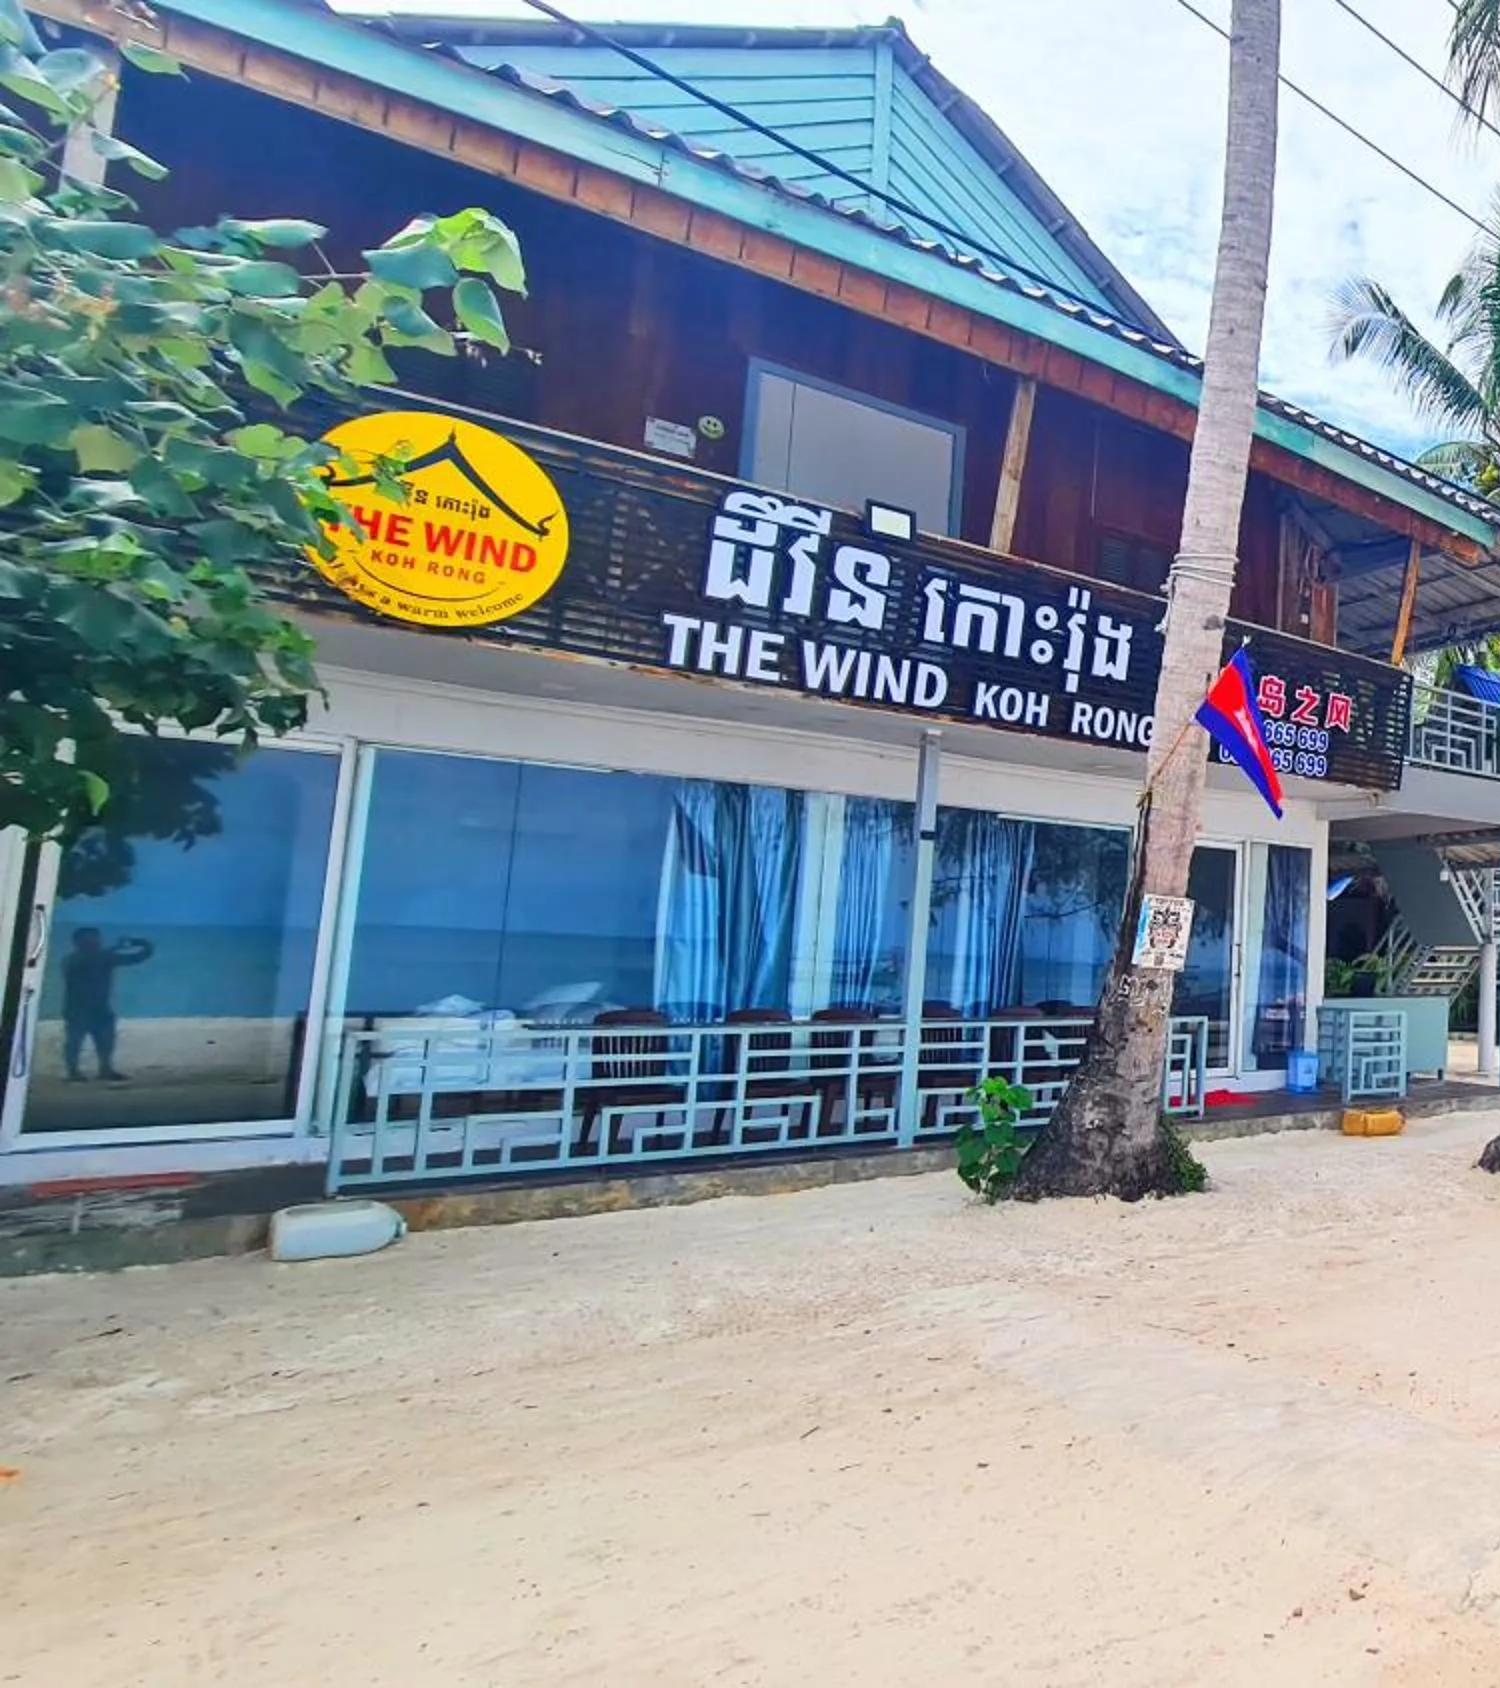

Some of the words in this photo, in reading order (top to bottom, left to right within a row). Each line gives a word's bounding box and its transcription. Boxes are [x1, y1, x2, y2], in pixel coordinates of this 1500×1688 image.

[329, 504, 414, 548] HE
[424, 521, 537, 573] WIND
[371, 550, 415, 569] KOH
[427, 562, 486, 585] RONG
[663, 613, 786, 682] THE
[803, 639, 949, 708] WIND
[973, 681, 1050, 728] KOH
[1298, 727, 1329, 752] 699
[1295, 752, 1327, 777] 699
